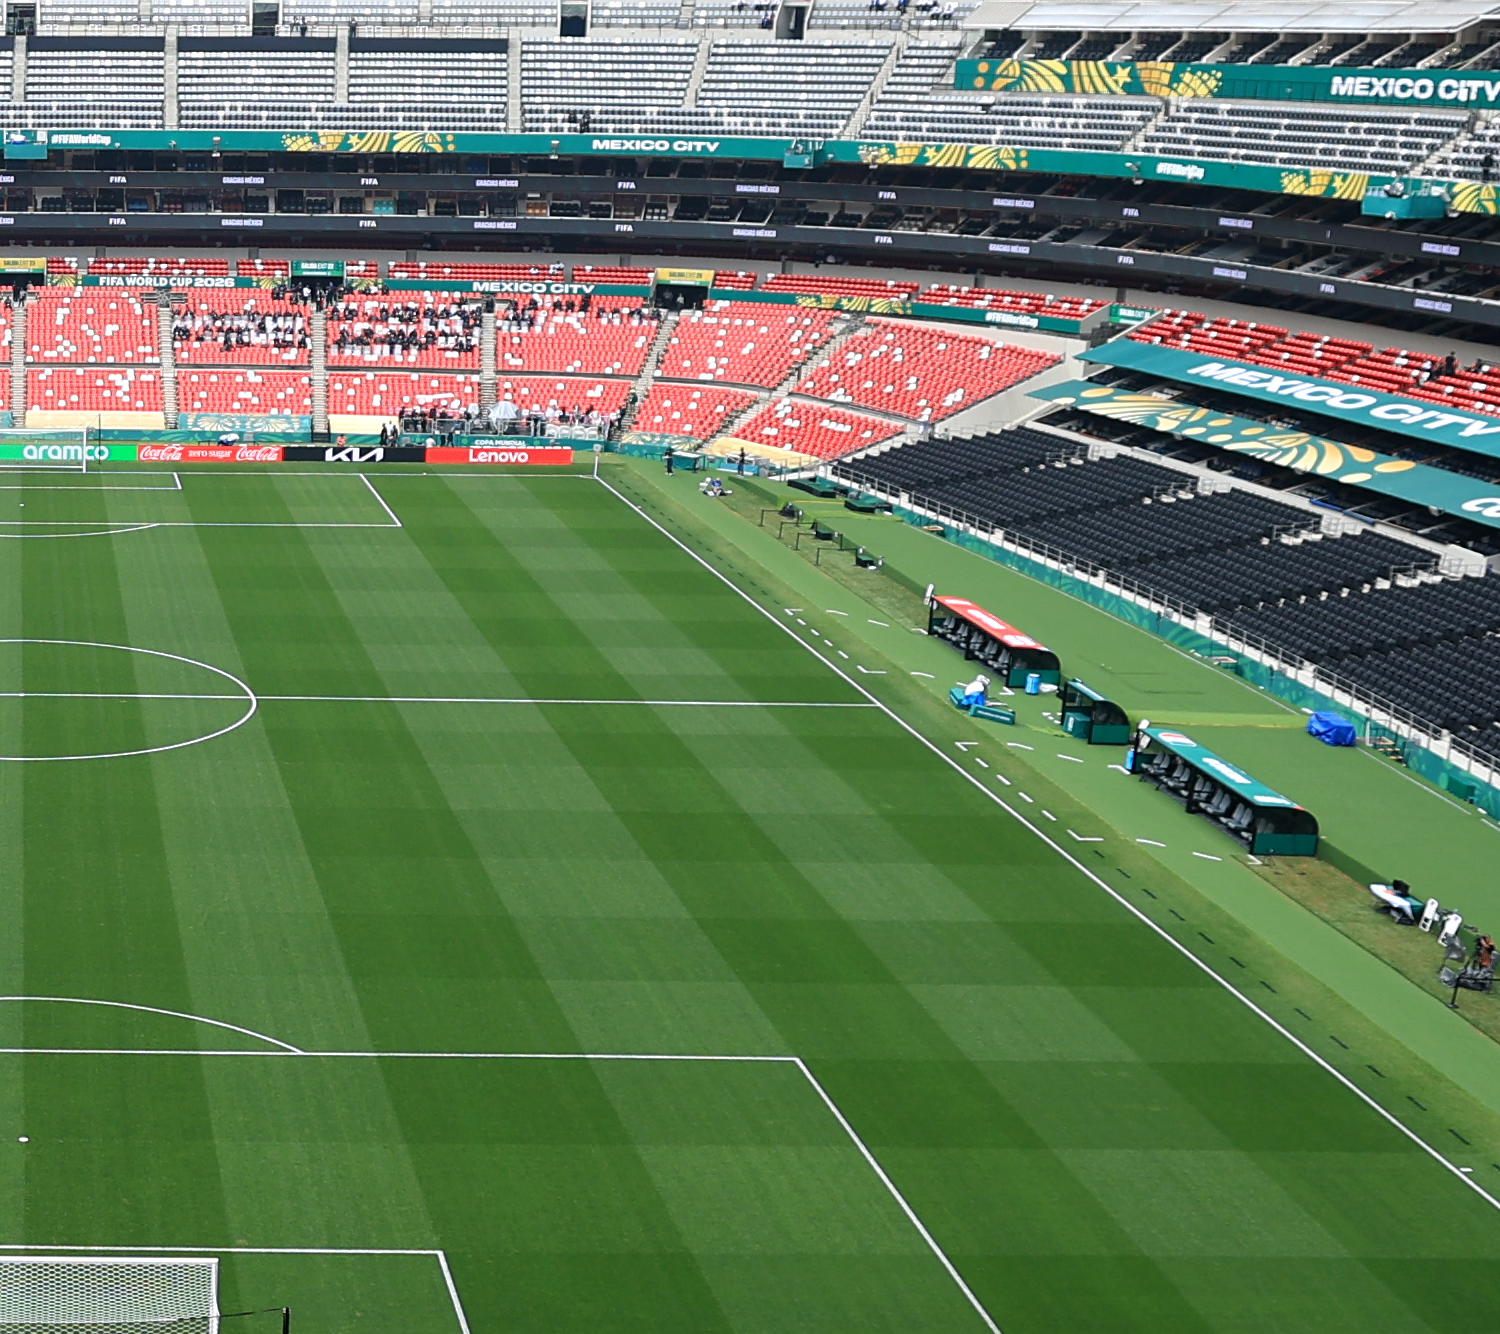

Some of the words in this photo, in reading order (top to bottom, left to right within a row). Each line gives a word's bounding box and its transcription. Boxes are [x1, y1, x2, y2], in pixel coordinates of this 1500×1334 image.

[1330, 75, 1434, 99] MEXICO
[50, 133, 112, 146] #FIFAWorldCup
[592, 139, 670, 151] MEXICO
[672, 140, 720, 153] CITY
[99, 277, 125, 287] FIFA
[126, 277, 168, 287] WORLD
[169, 277, 192, 287] CUP
[193, 277, 235, 287] 2026
[471, 281, 546, 293] MEXICO
[547, 281, 595, 294] CITY
[1187, 361, 1377, 411] MEXICO
[22, 444, 109, 460] aramco
[188, 450, 208, 459] zero
[208, 450, 232, 460] sugar
[325, 447, 384, 462] KIA
[469, 448, 529, 463] Lenovo
